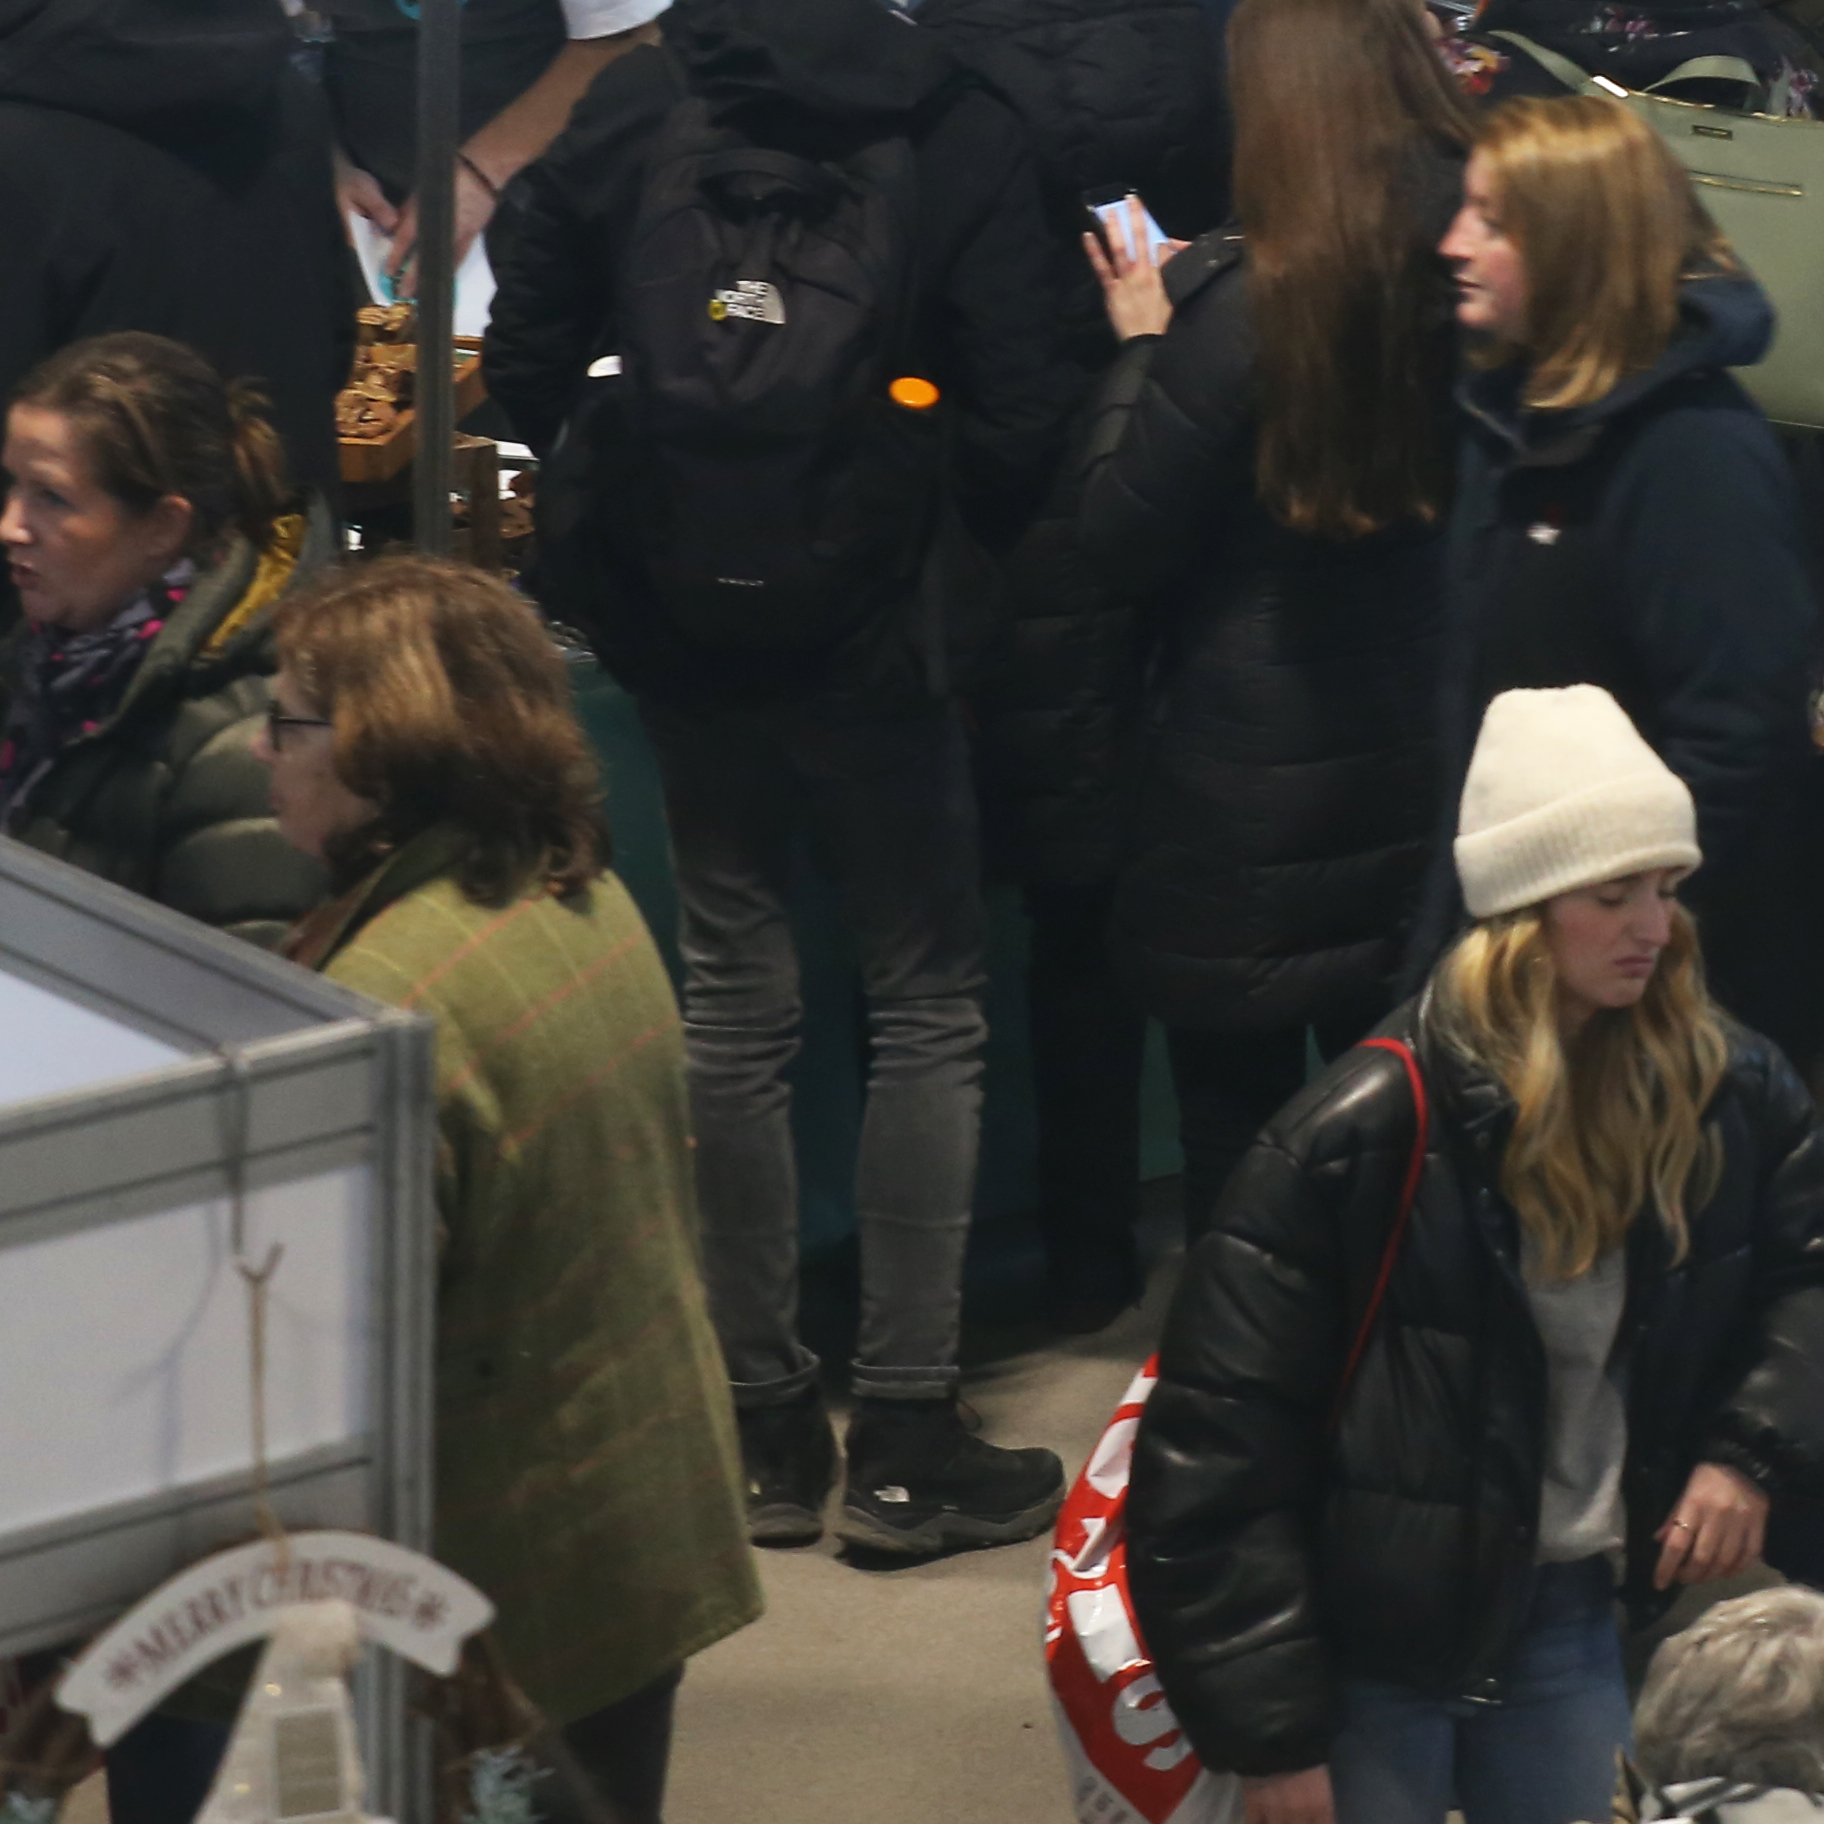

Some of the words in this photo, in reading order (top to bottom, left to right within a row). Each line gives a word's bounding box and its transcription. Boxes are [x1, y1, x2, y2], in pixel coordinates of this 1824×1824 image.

[736, 280, 768, 295] THE
[726, 304, 766, 322] FACE
[133, 1579, 246, 1668] MERRY
